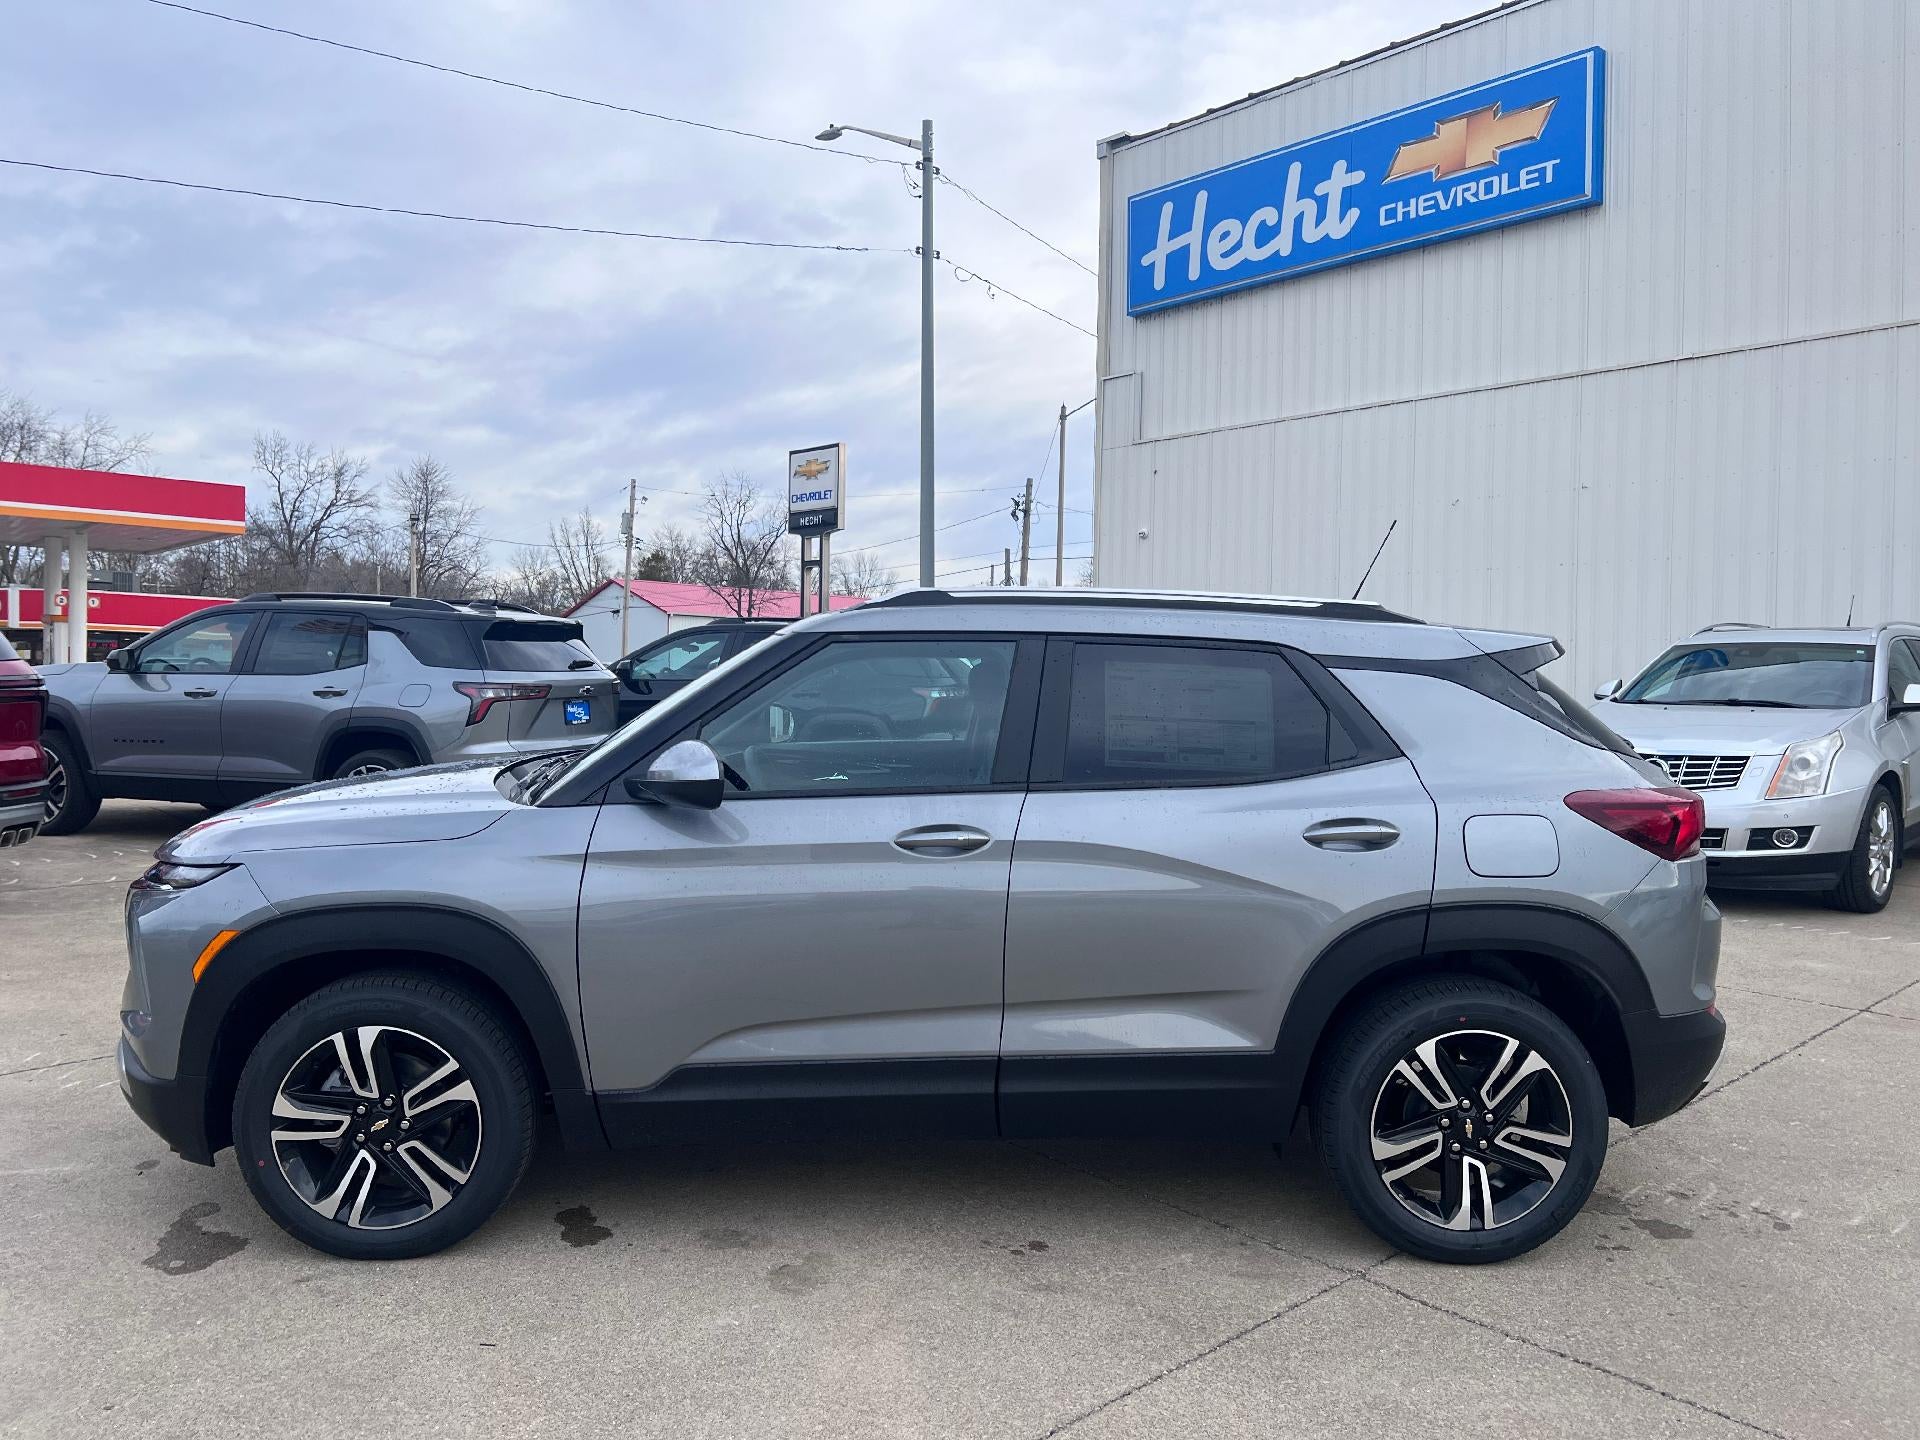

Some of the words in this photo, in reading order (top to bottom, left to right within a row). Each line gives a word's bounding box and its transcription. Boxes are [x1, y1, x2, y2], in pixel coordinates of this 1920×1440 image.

[1379, 159, 1560, 226] CHEVROLET
[1141, 159, 1365, 290] Hecht
[791, 490, 832, 503] CHEVROLET
[800, 515, 822, 526] HECHT
